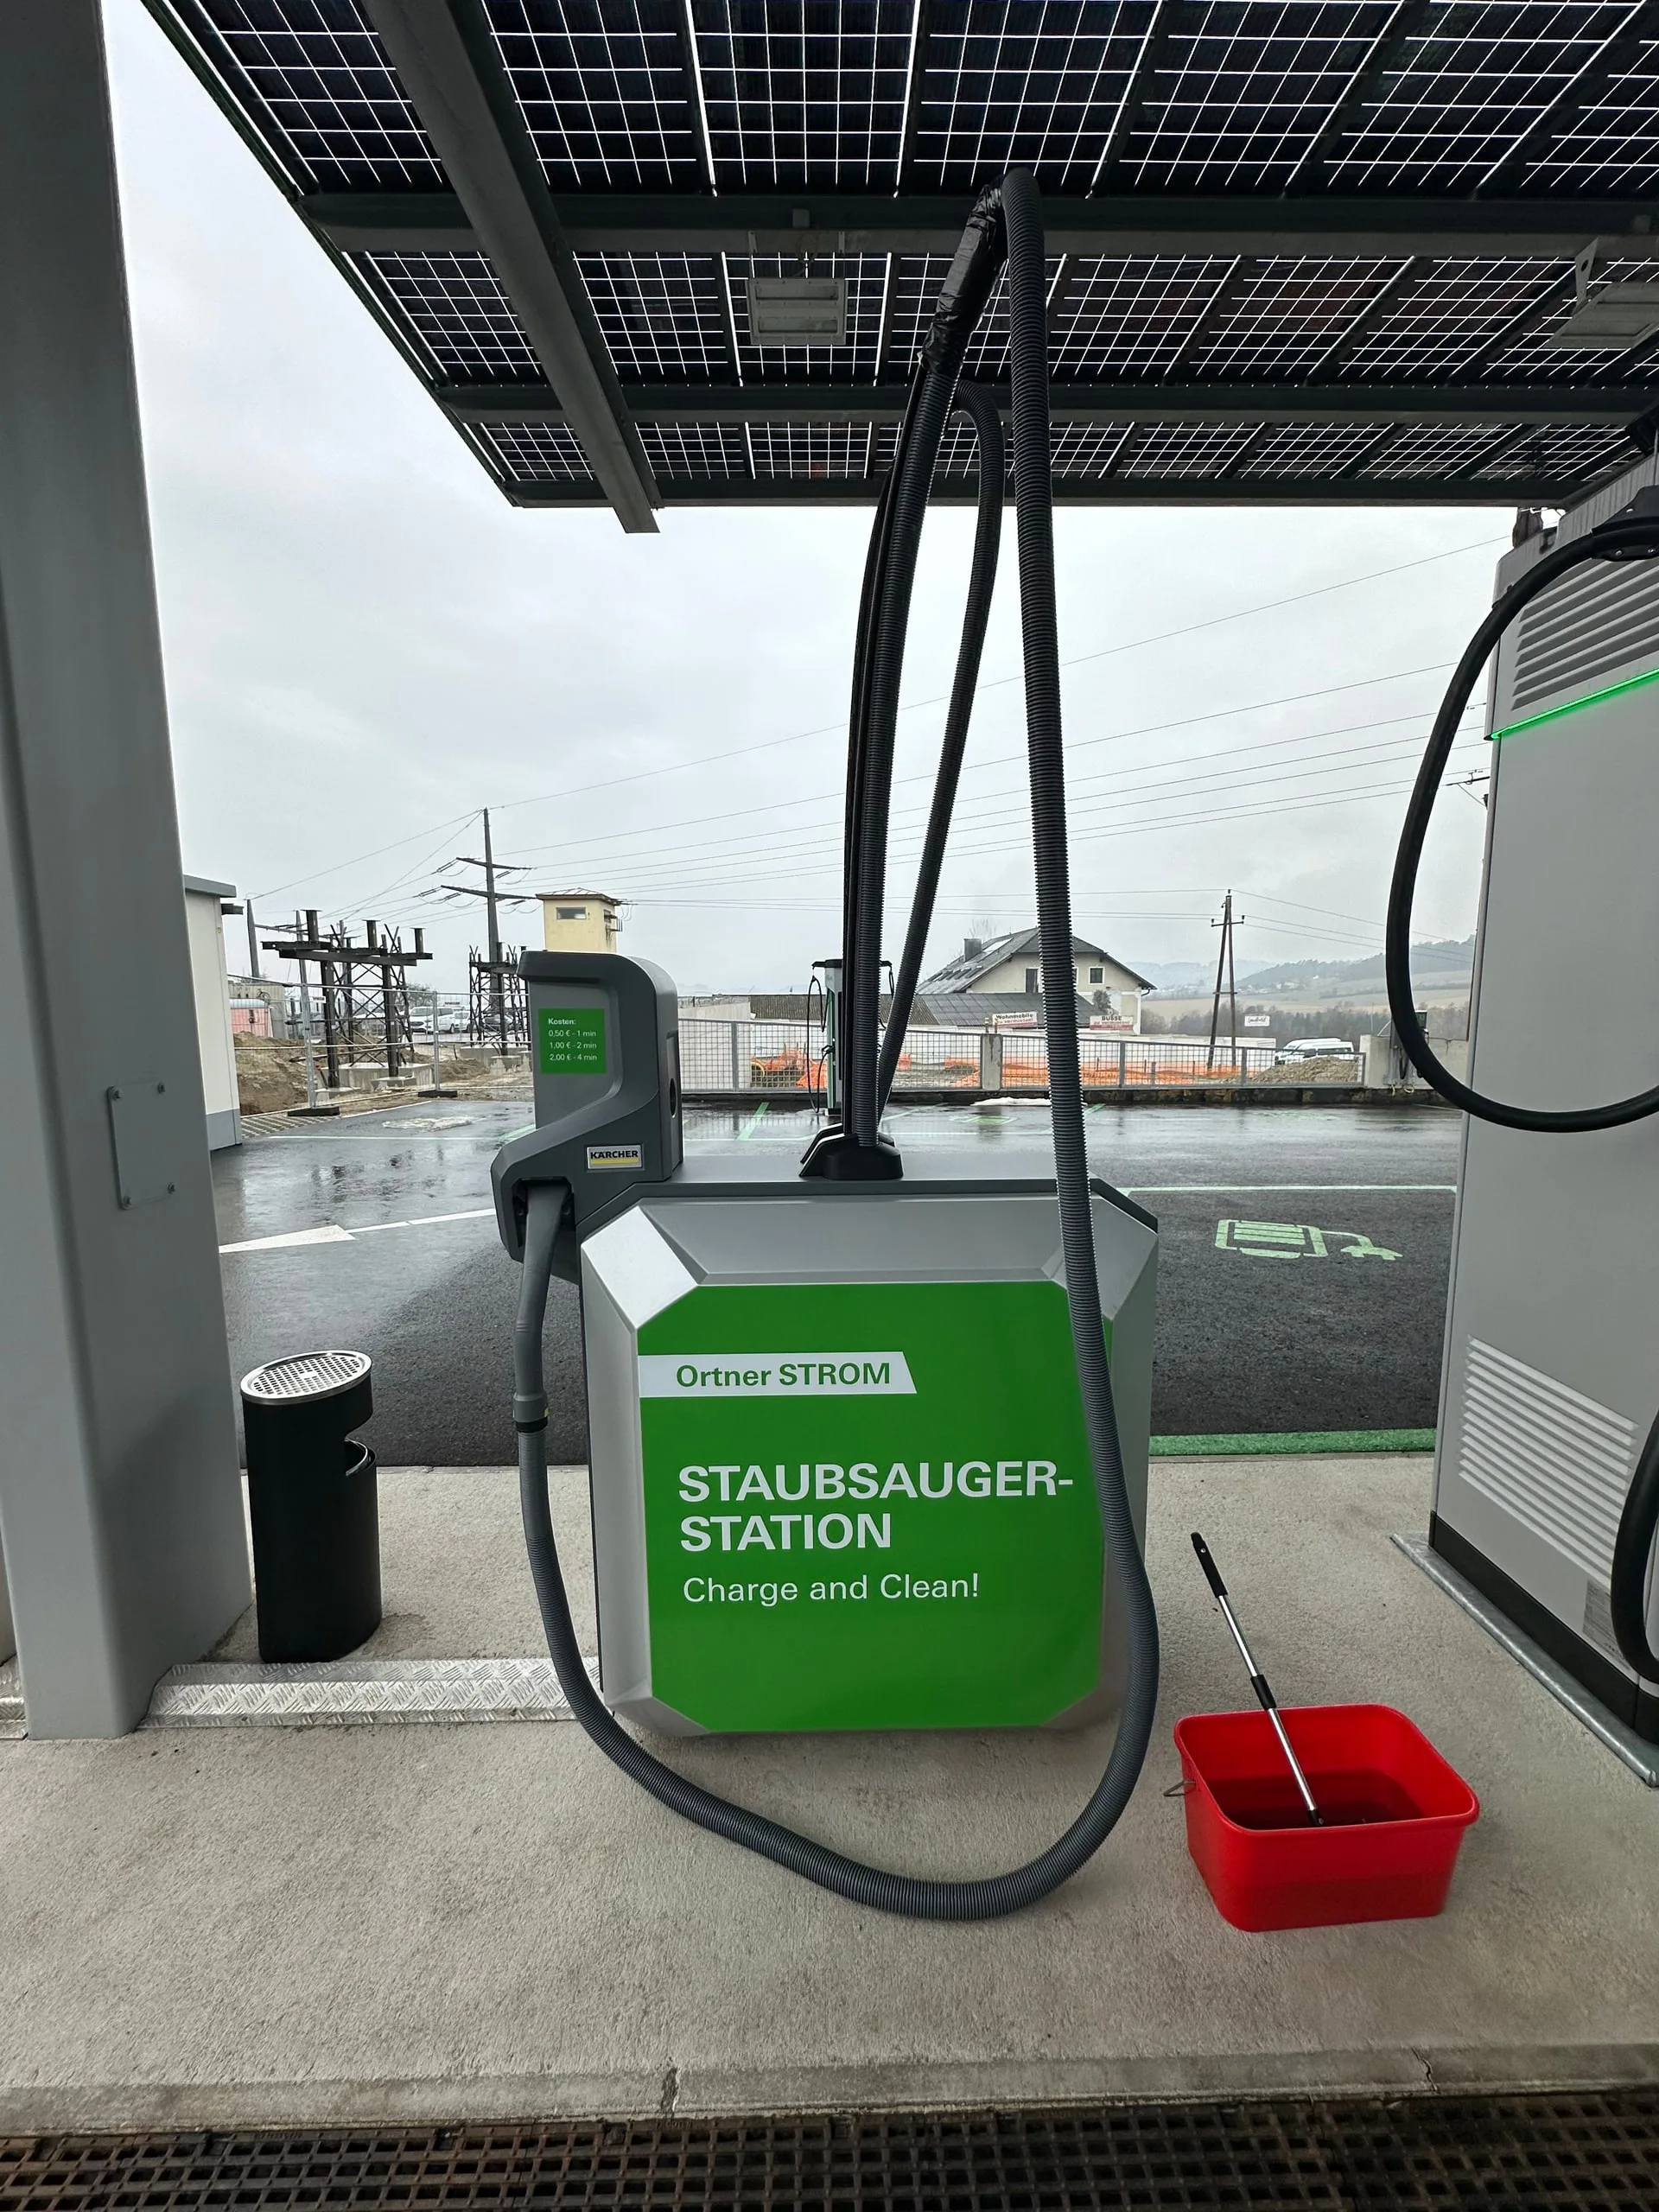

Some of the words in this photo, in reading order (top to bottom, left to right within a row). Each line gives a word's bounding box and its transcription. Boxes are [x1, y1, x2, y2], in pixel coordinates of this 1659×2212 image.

[677, 1364, 772, 1387] Ortner
[779, 1362, 890, 1385] STROM
[678, 1460, 1074, 1503] STAUBSAUGER-
[680, 1513, 891, 1552] STATION
[683, 1577, 798, 1607] Charge
[810, 1574, 867, 1599] and
[880, 1573, 979, 1599] Clean!
